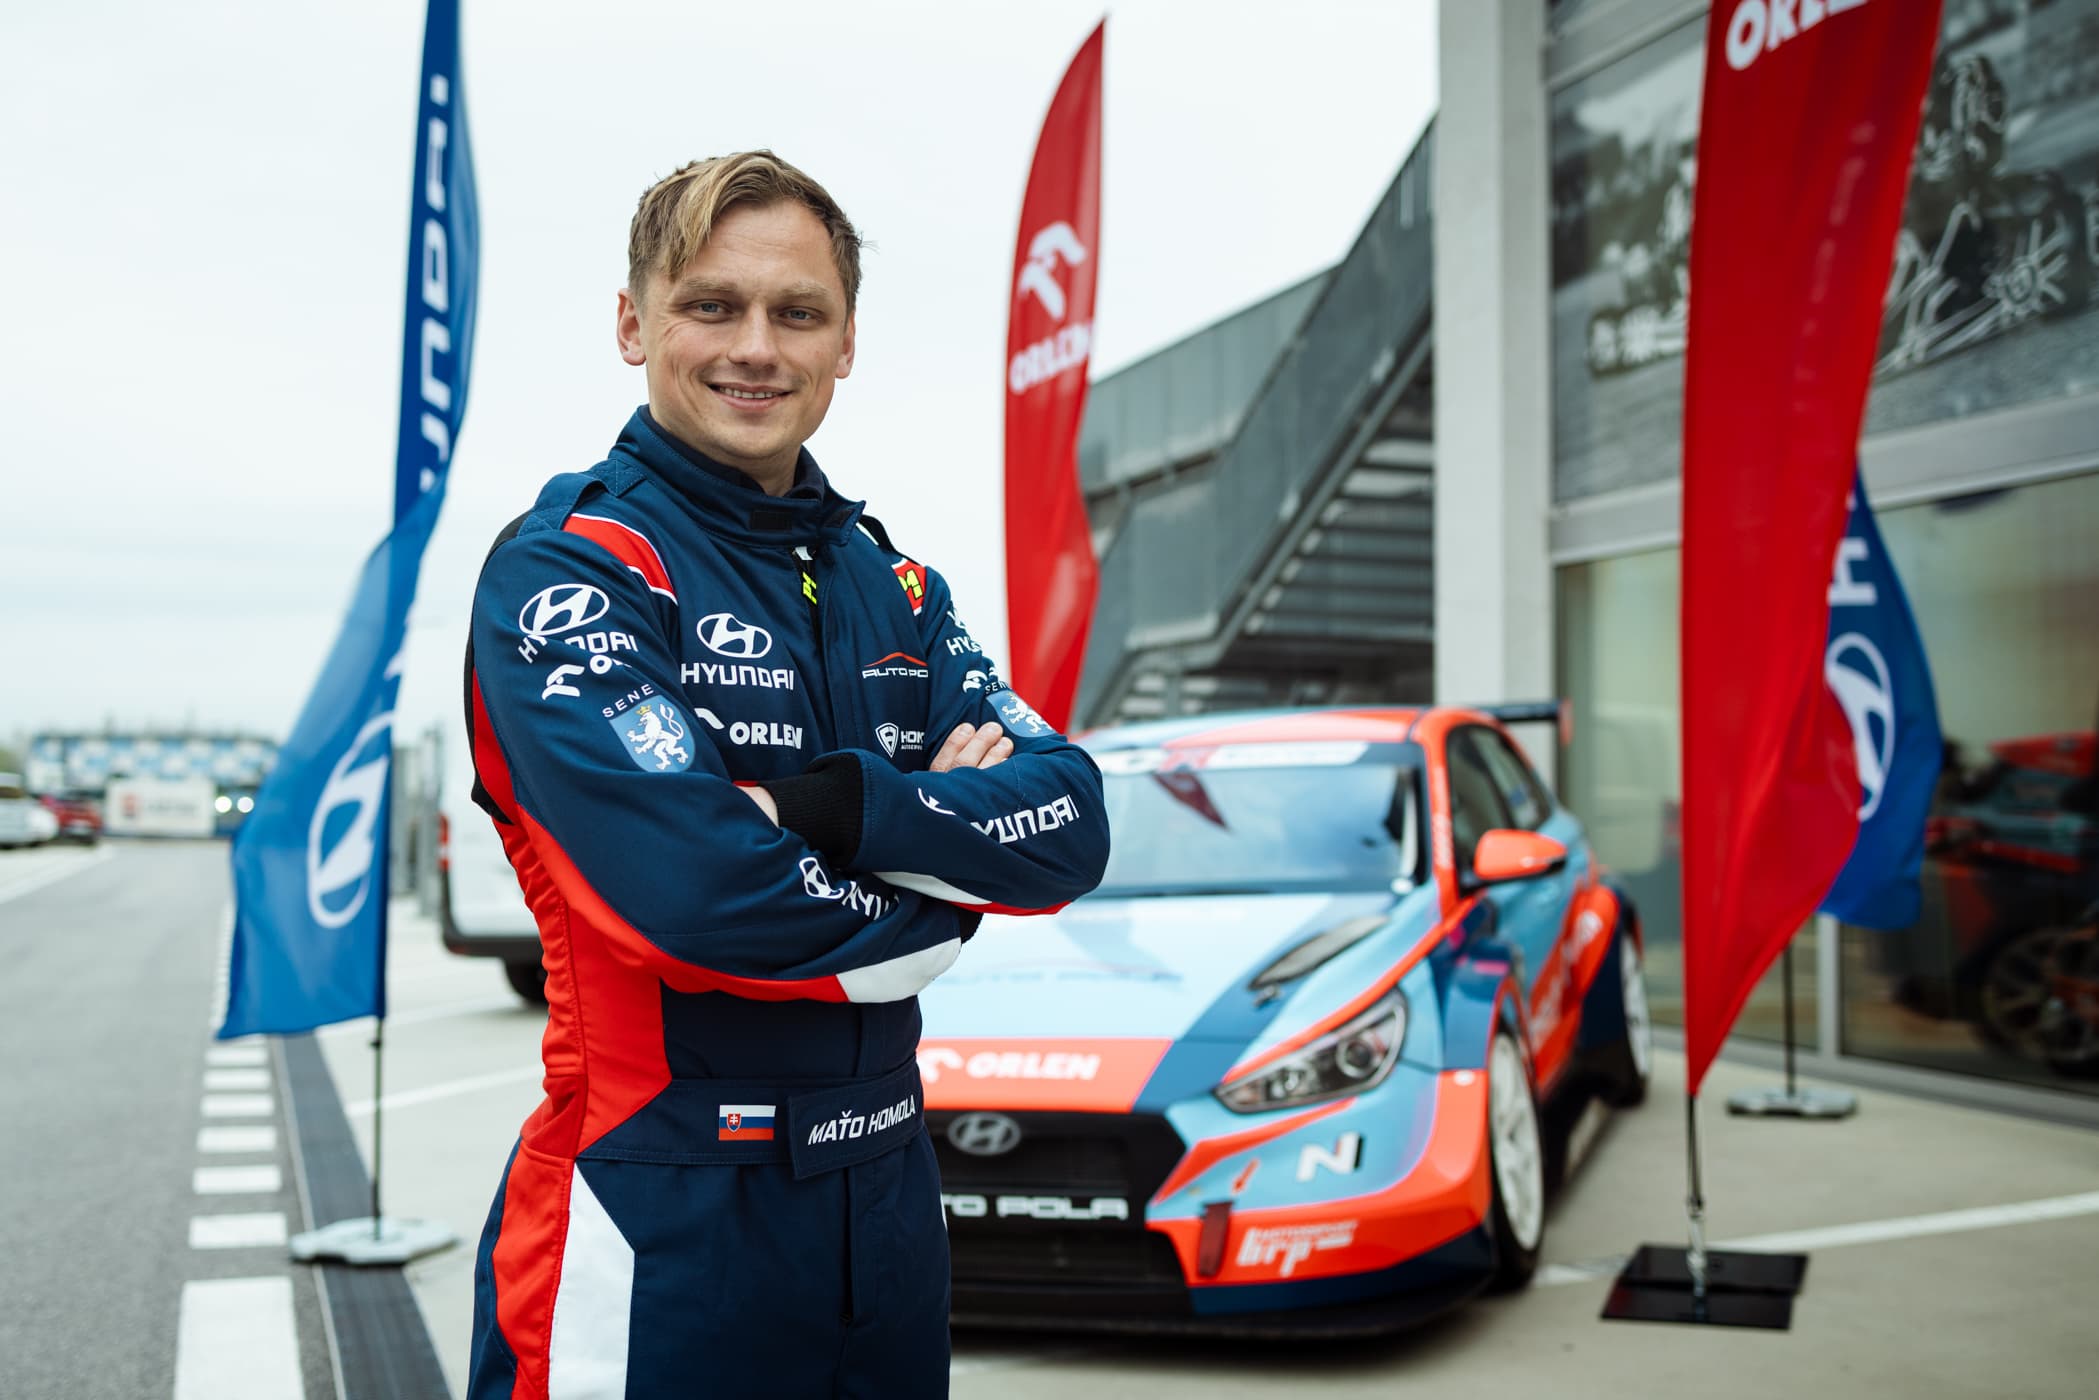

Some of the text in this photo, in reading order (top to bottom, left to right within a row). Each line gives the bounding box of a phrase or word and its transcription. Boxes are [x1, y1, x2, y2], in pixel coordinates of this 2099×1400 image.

[518, 631, 639, 664] HYNDAI
[680, 662, 795, 690] HYUNDAI
[729, 721, 803, 750] ORLEN
[970, 794, 1080, 844] YUNDAI
[965, 1051, 1101, 1081] ORLEN
[807, 1094, 917, 1146] MAŤO HOMOLA
[996, 1196, 1129, 1220] POLA
